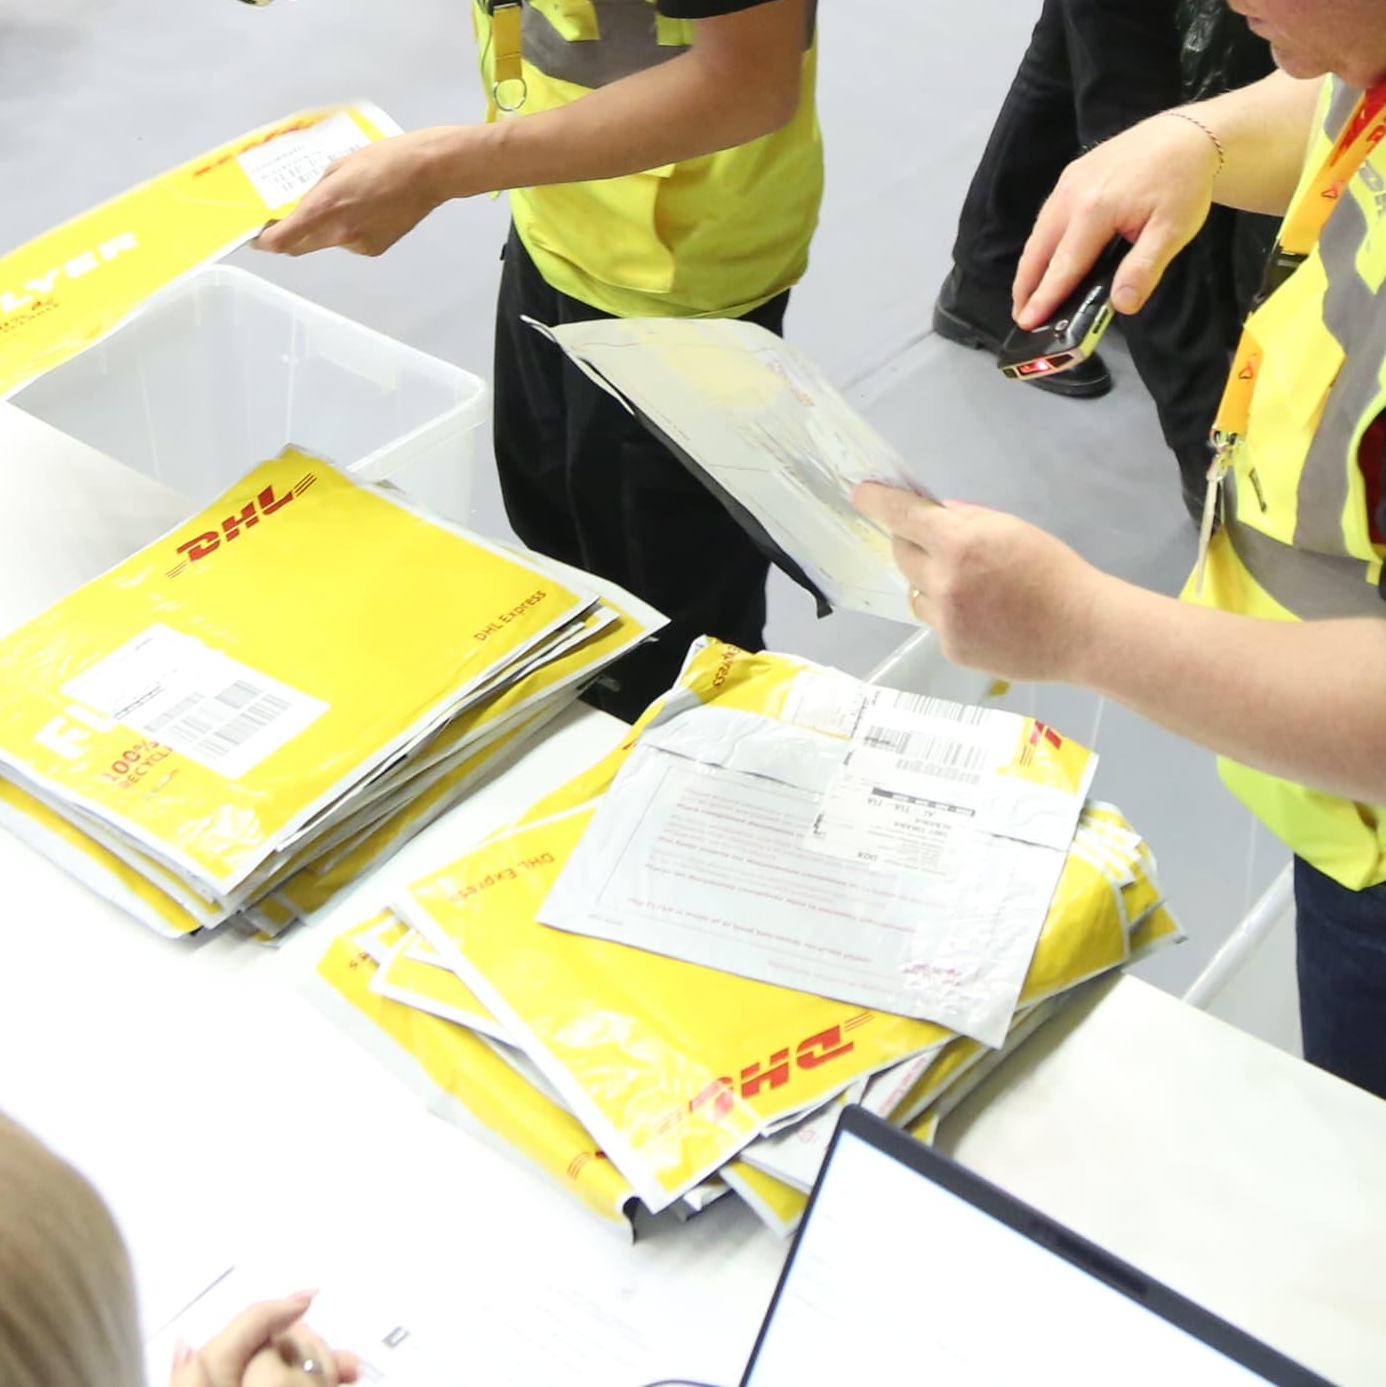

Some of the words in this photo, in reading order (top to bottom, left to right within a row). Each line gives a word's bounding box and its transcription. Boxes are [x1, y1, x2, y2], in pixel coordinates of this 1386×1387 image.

[175, 484, 295, 563] DHL
[474, 623, 504, 642] DHL
[499, 590, 547, 623] Express
[688, 1025, 855, 1121] DHL
